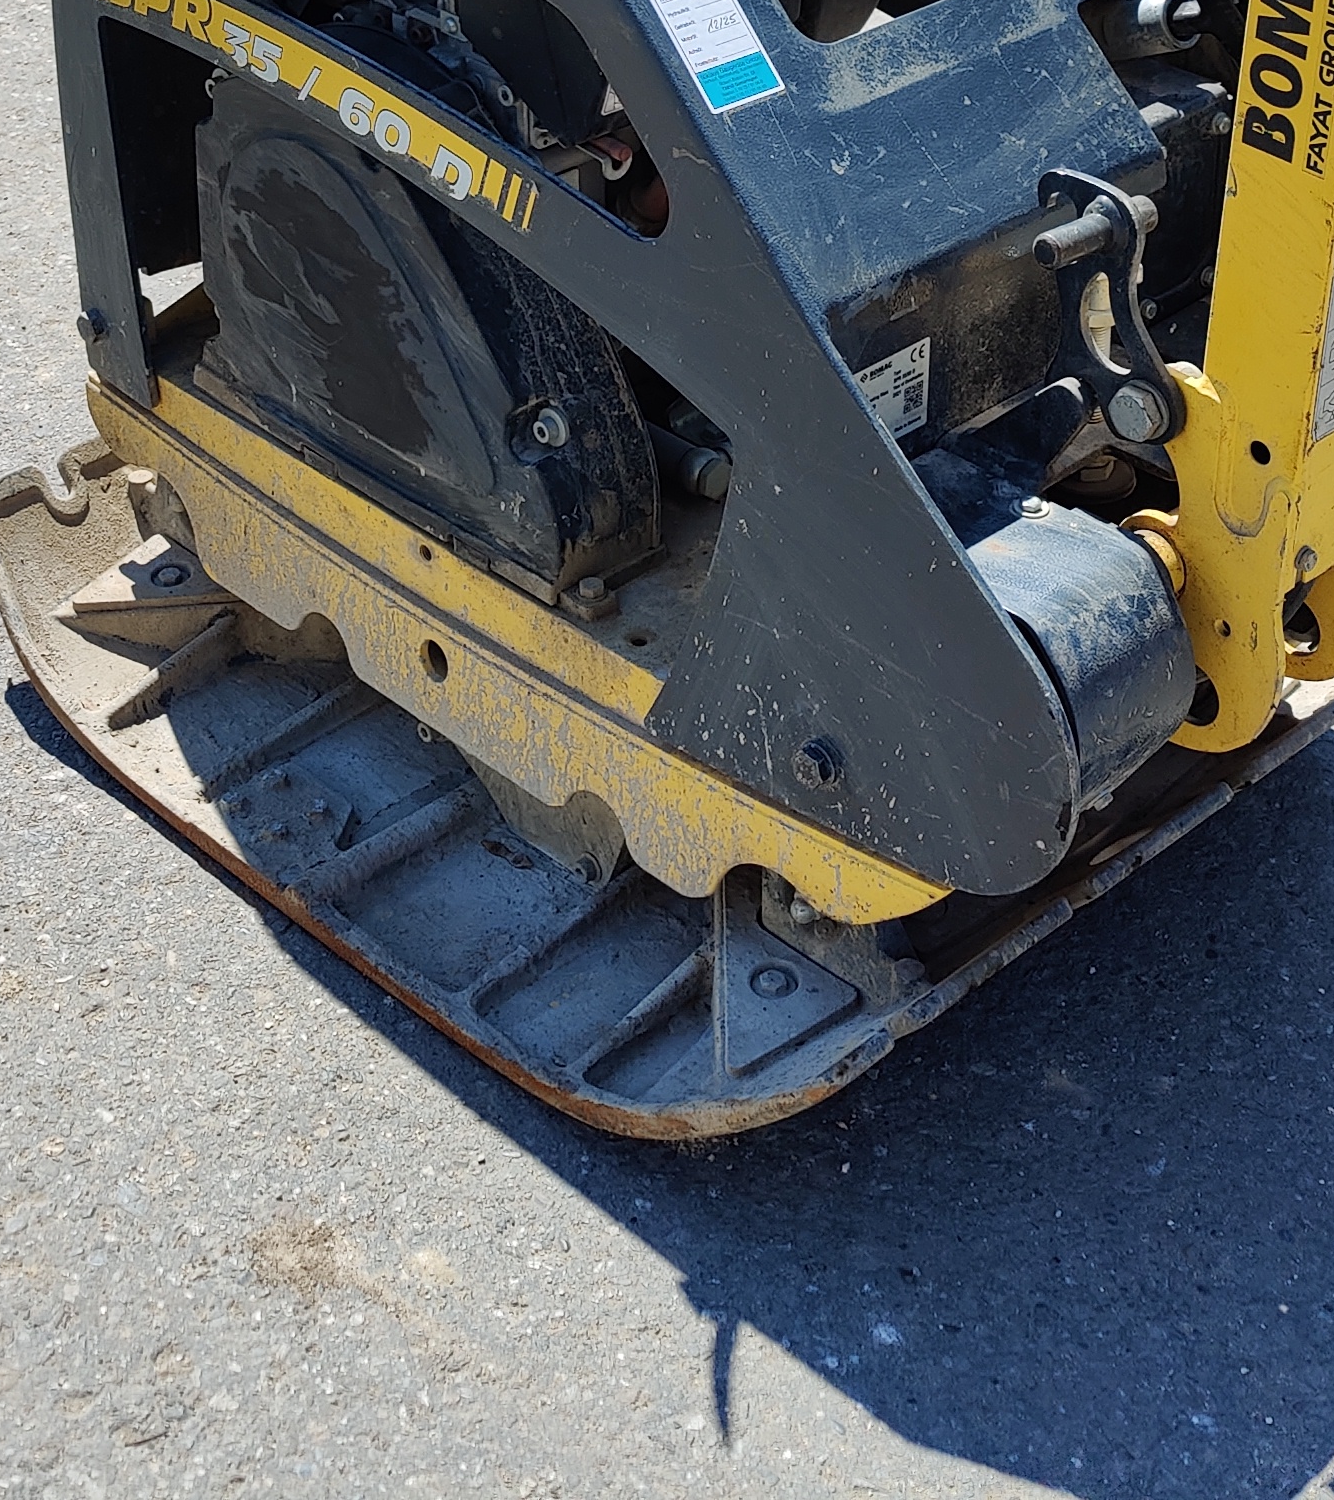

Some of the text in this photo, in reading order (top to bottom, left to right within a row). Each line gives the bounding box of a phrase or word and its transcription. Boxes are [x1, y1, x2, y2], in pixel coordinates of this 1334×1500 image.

[220, 20, 283, 84] 35
[297, 67, 321, 101] /
[338, 86, 412, 156] 60
[431, 144, 475, 201] D
[1306, 92, 1333, 175] FAYAT
[870, 361, 892, 378] BOMAG
